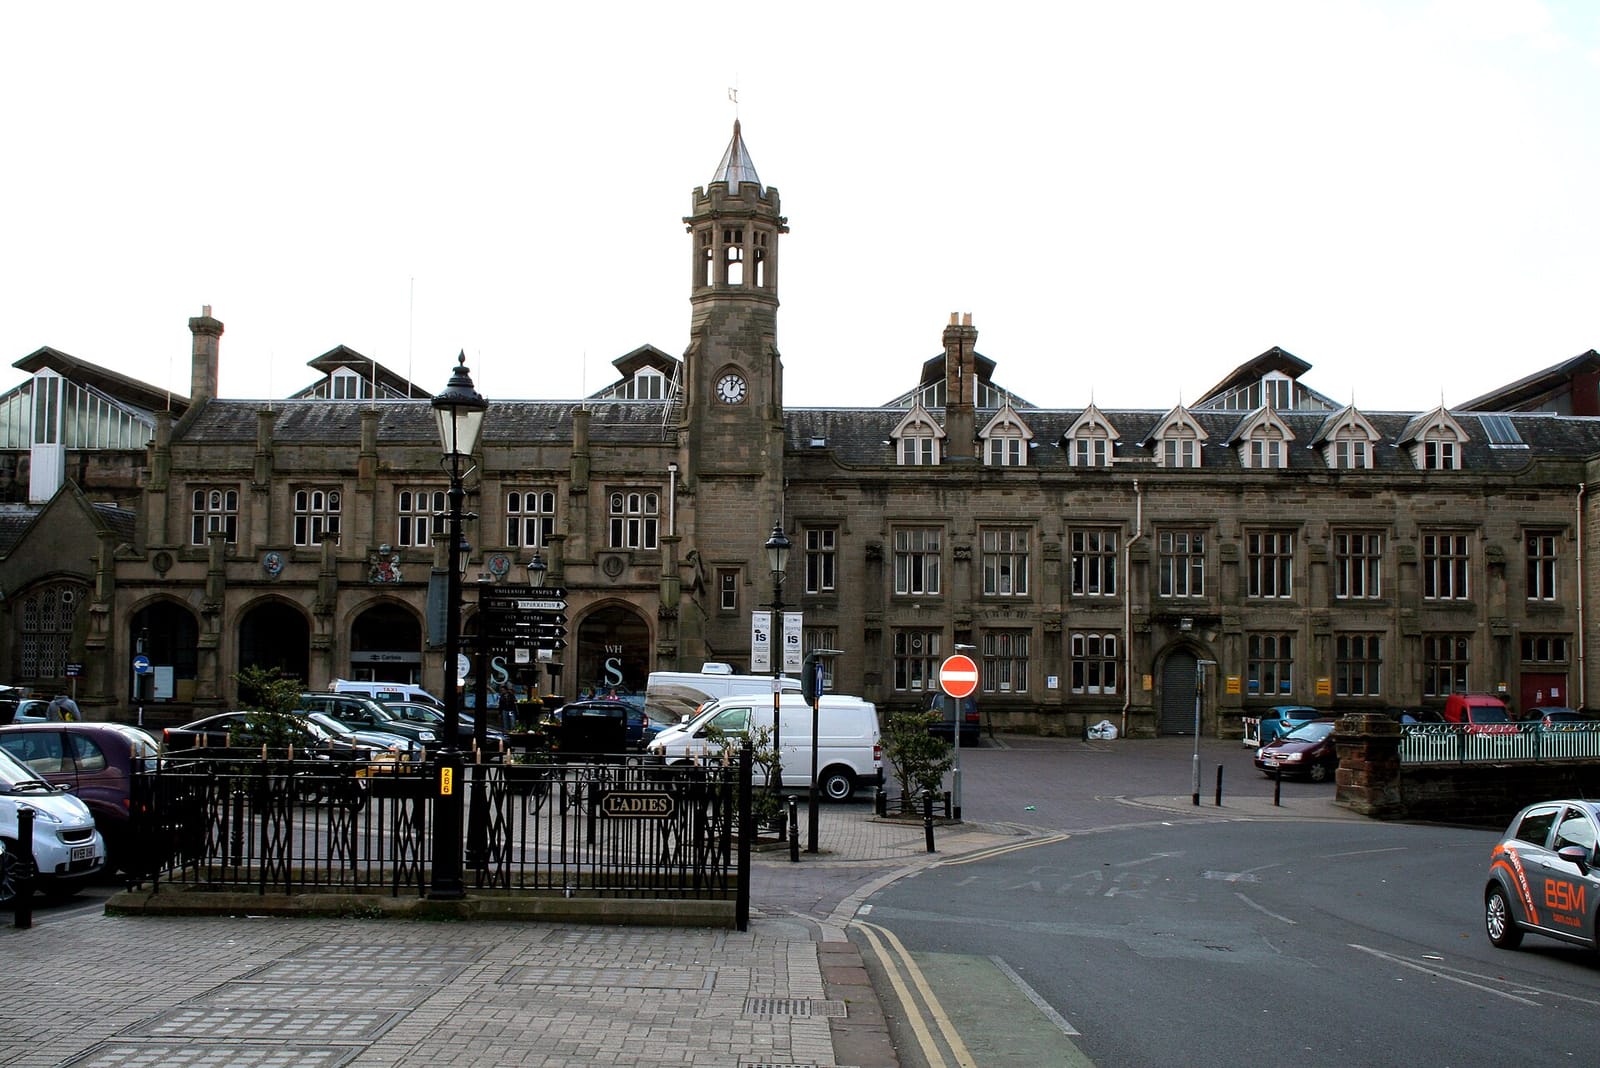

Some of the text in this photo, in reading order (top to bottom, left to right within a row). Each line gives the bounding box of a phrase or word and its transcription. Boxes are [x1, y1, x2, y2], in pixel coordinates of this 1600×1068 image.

[604, 645, 623, 654] WH
[490, 656, 509, 684] S
[604, 657, 623, 686] S
[609, 798, 667, 811] LADIES
[1545, 878, 1587, 915] BSM
